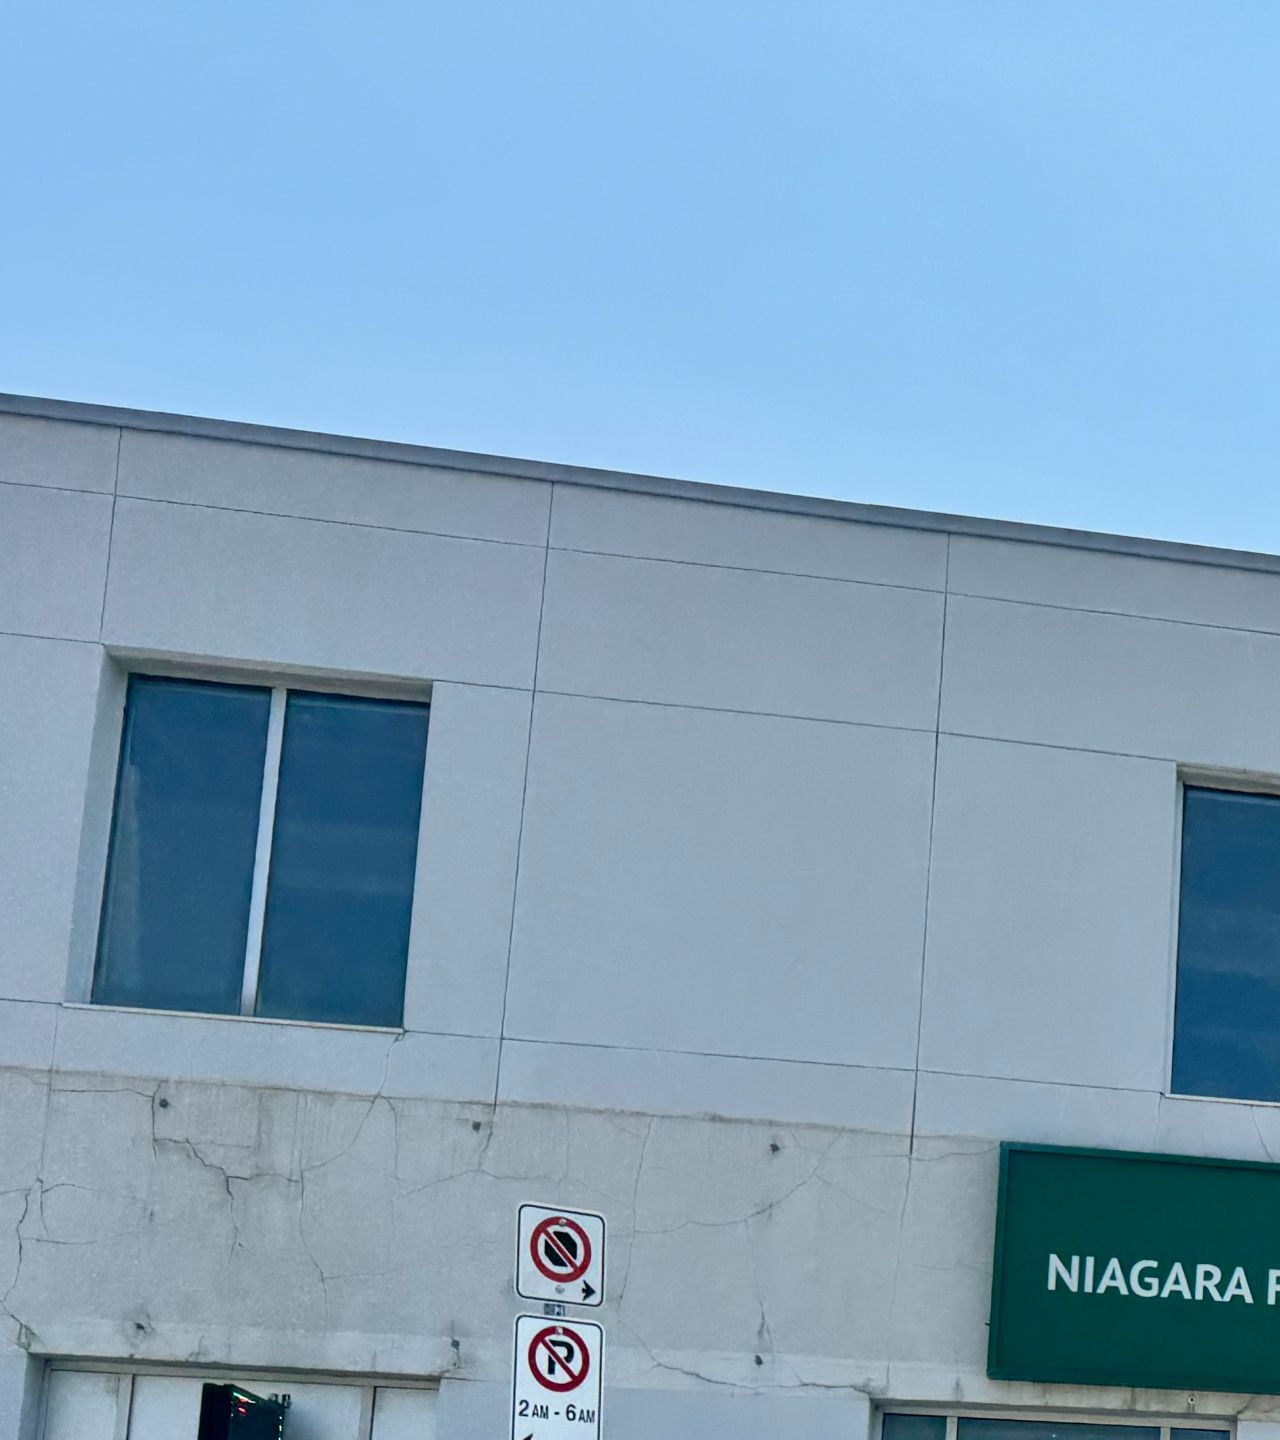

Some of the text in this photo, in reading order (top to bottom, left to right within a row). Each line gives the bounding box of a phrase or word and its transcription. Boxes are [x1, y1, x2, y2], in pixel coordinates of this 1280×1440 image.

[1047, 1253, 1254, 1304] NIAGARA
[518, 1399, 530, 1417] 2
[531, 1404, 549, 1419] AM
[565, 1403, 577, 1421] 6
[577, 1408, 596, 1423] AM
